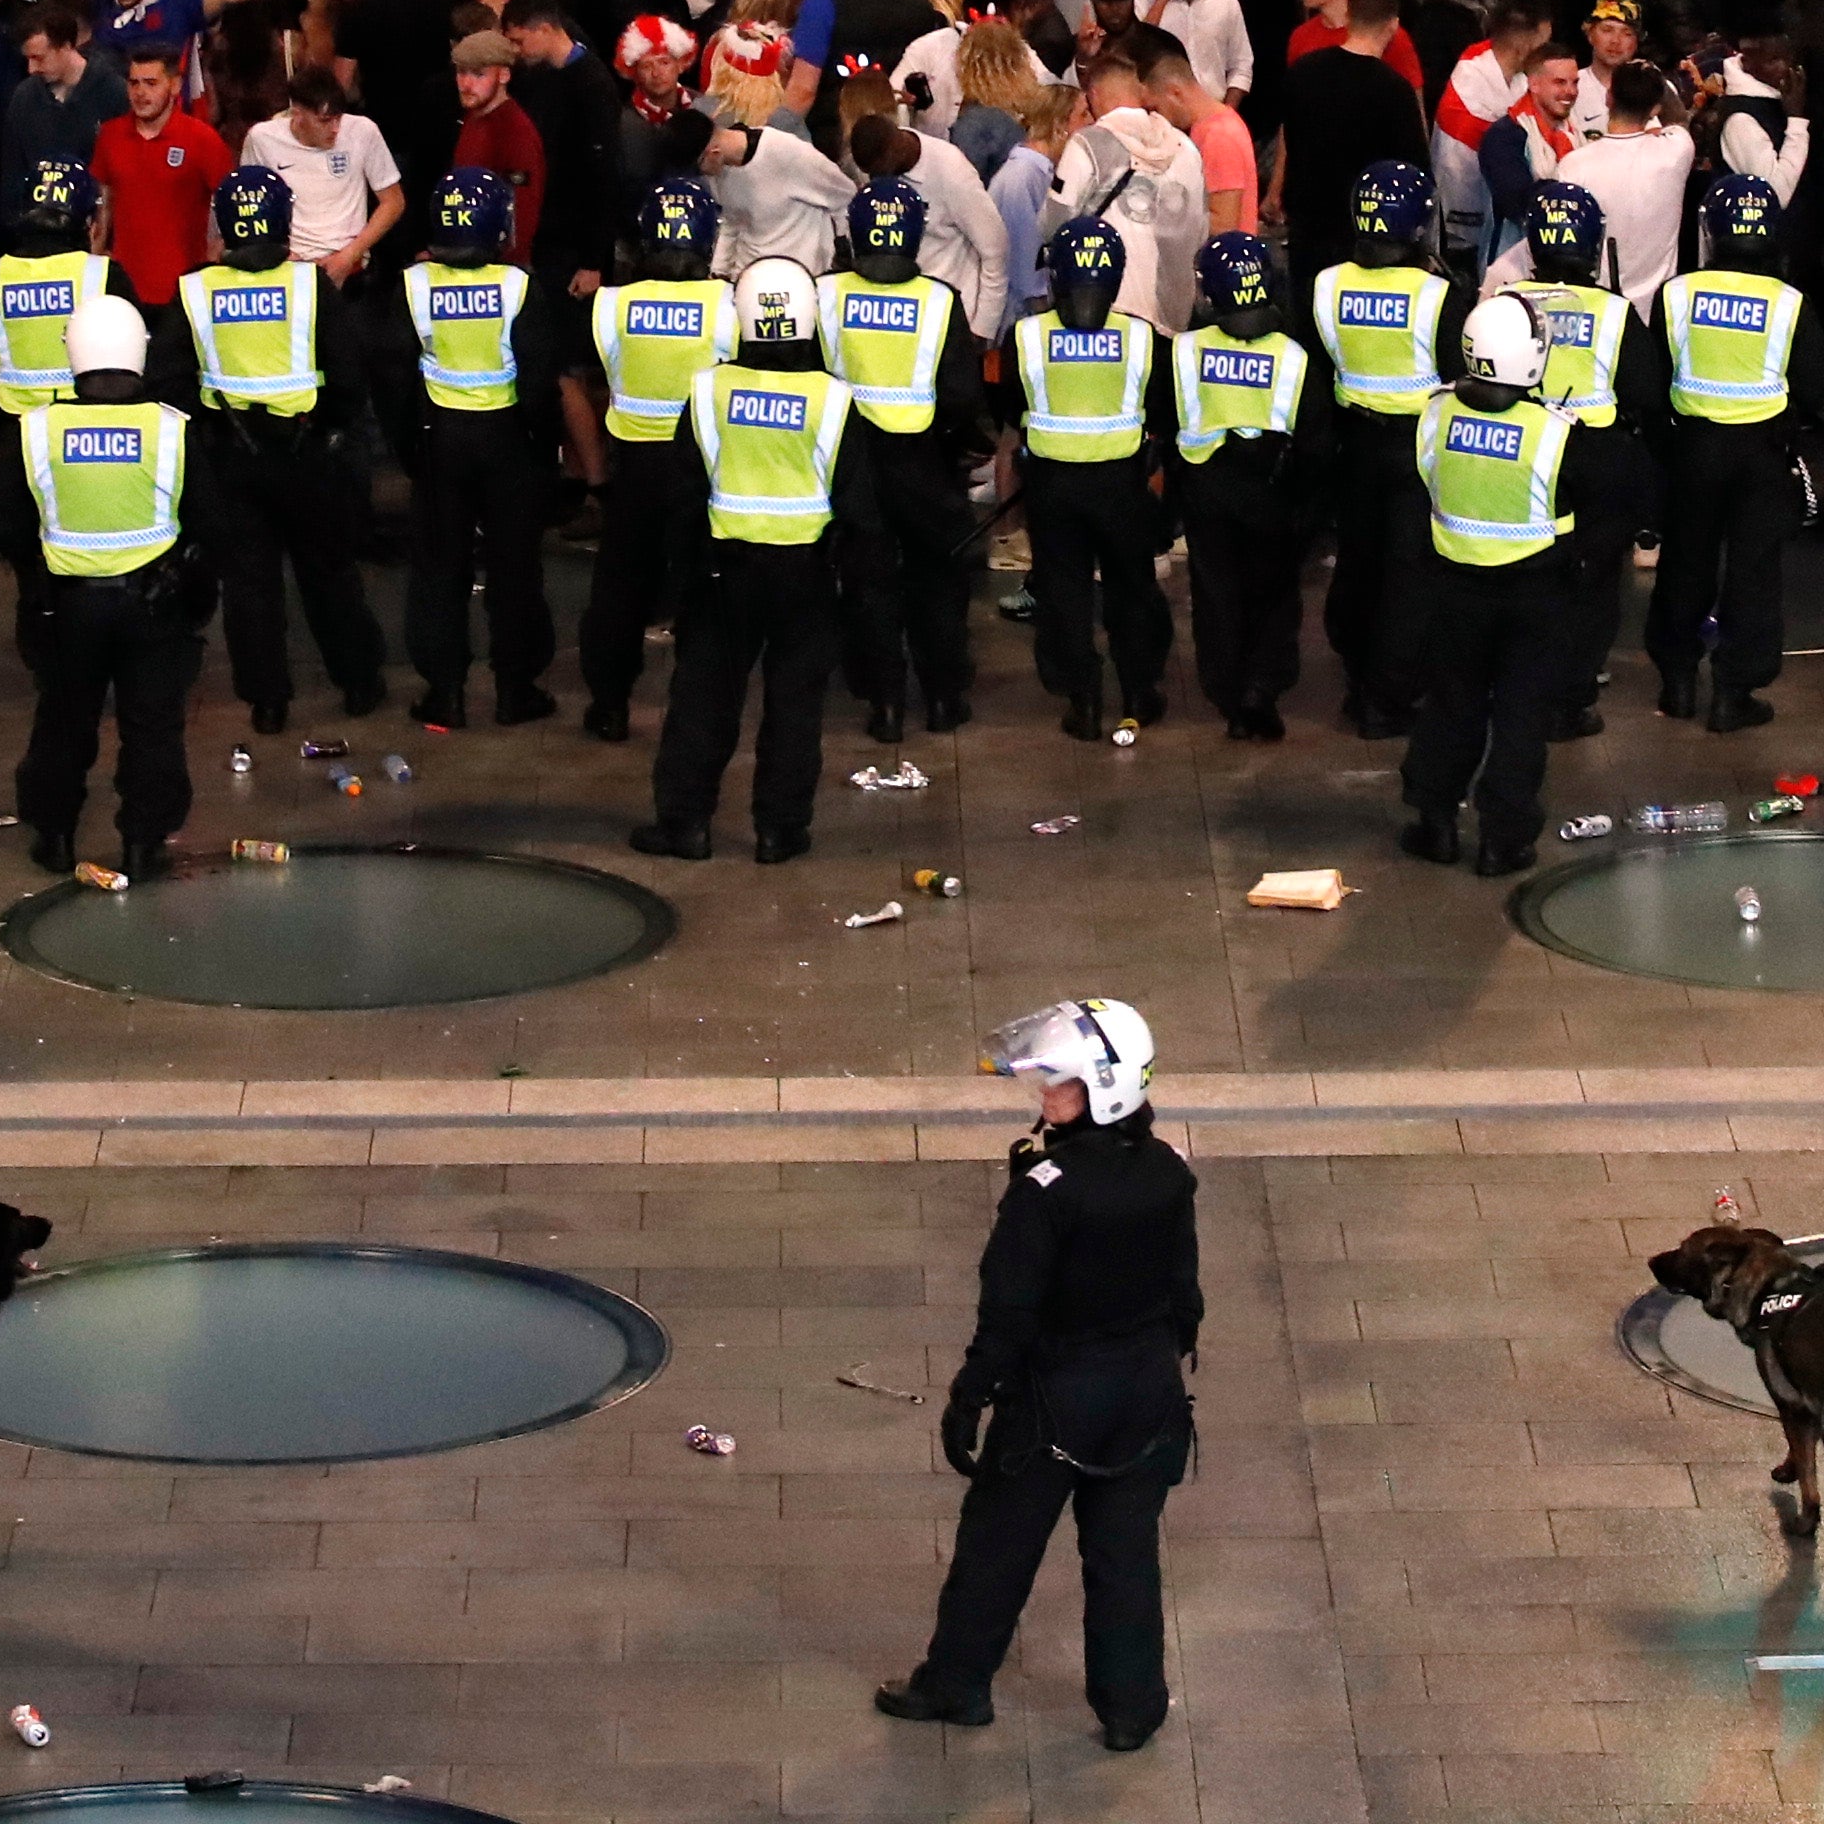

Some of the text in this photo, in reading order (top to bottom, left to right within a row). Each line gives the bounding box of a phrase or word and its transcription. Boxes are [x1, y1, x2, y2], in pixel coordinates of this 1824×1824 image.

[41, 172, 64, 183] MP
[238, 204, 259, 217] MP
[444, 194, 464, 206] MP
[1360, 201, 1379, 213] MP
[663, 206, 685, 219] MP
[875, 213, 898, 226] MP
[1547, 211, 1568, 223] MP
[1742, 208, 1763, 221] MP
[1083, 236, 1105, 249] MP
[1241, 274, 1261, 288] MP
[4, 284, 73, 313] POLICE
[213, 290, 285, 317] POLICE
[432, 288, 499, 315] POLICE
[1341, 295, 1406, 323] POLICE
[628, 305, 700, 332] POLICE
[763, 305, 786, 318] MP
[845, 298, 917, 326] POLICE
[1694, 295, 1767, 327] POLICE
[1050, 333, 1120, 358] POLICE
[1202, 354, 1273, 383] POLICE
[730, 394, 804, 425] POLICE
[65, 432, 139, 458] POLICE
[1448, 419, 1520, 454] POLICE
[1760, 1293, 1804, 1316] POLICE
